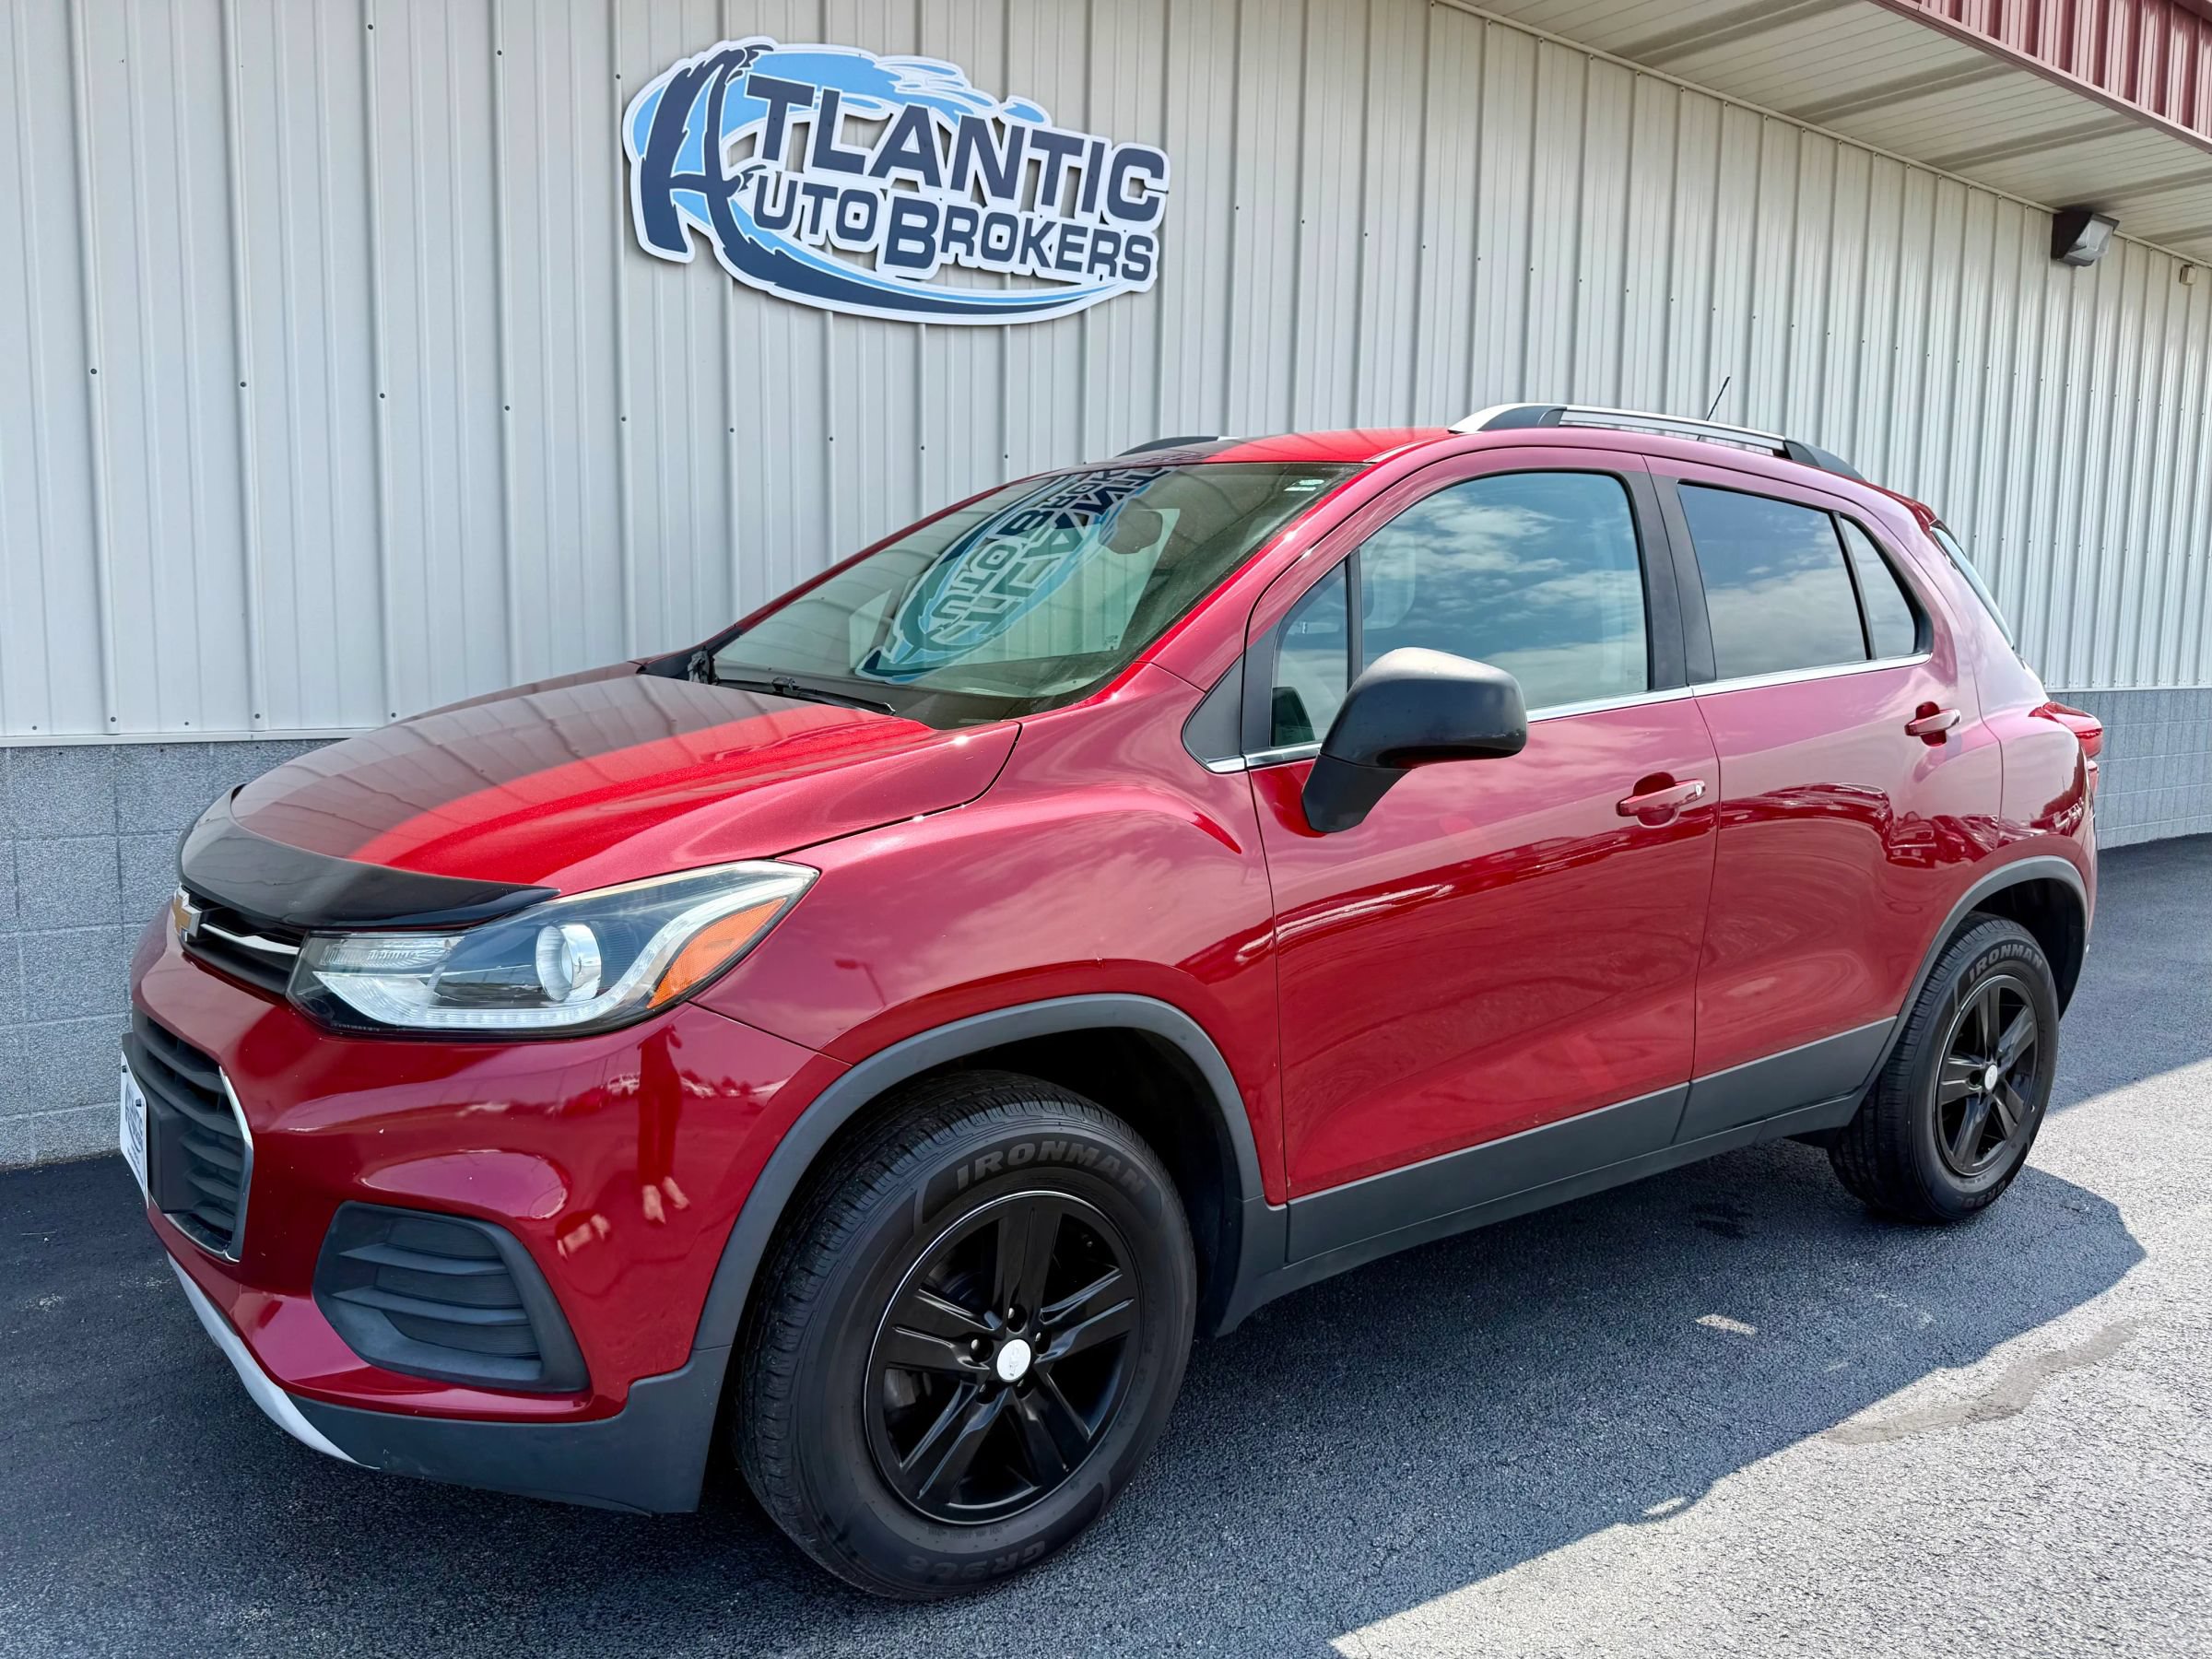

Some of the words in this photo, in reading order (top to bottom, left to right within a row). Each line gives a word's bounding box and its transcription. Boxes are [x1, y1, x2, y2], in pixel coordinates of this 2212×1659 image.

[885, 195, 1153, 280] BROKERS
[1969, 944, 2043, 983] IRONMAN
[957, 1140, 1147, 1195] IRONMAN
